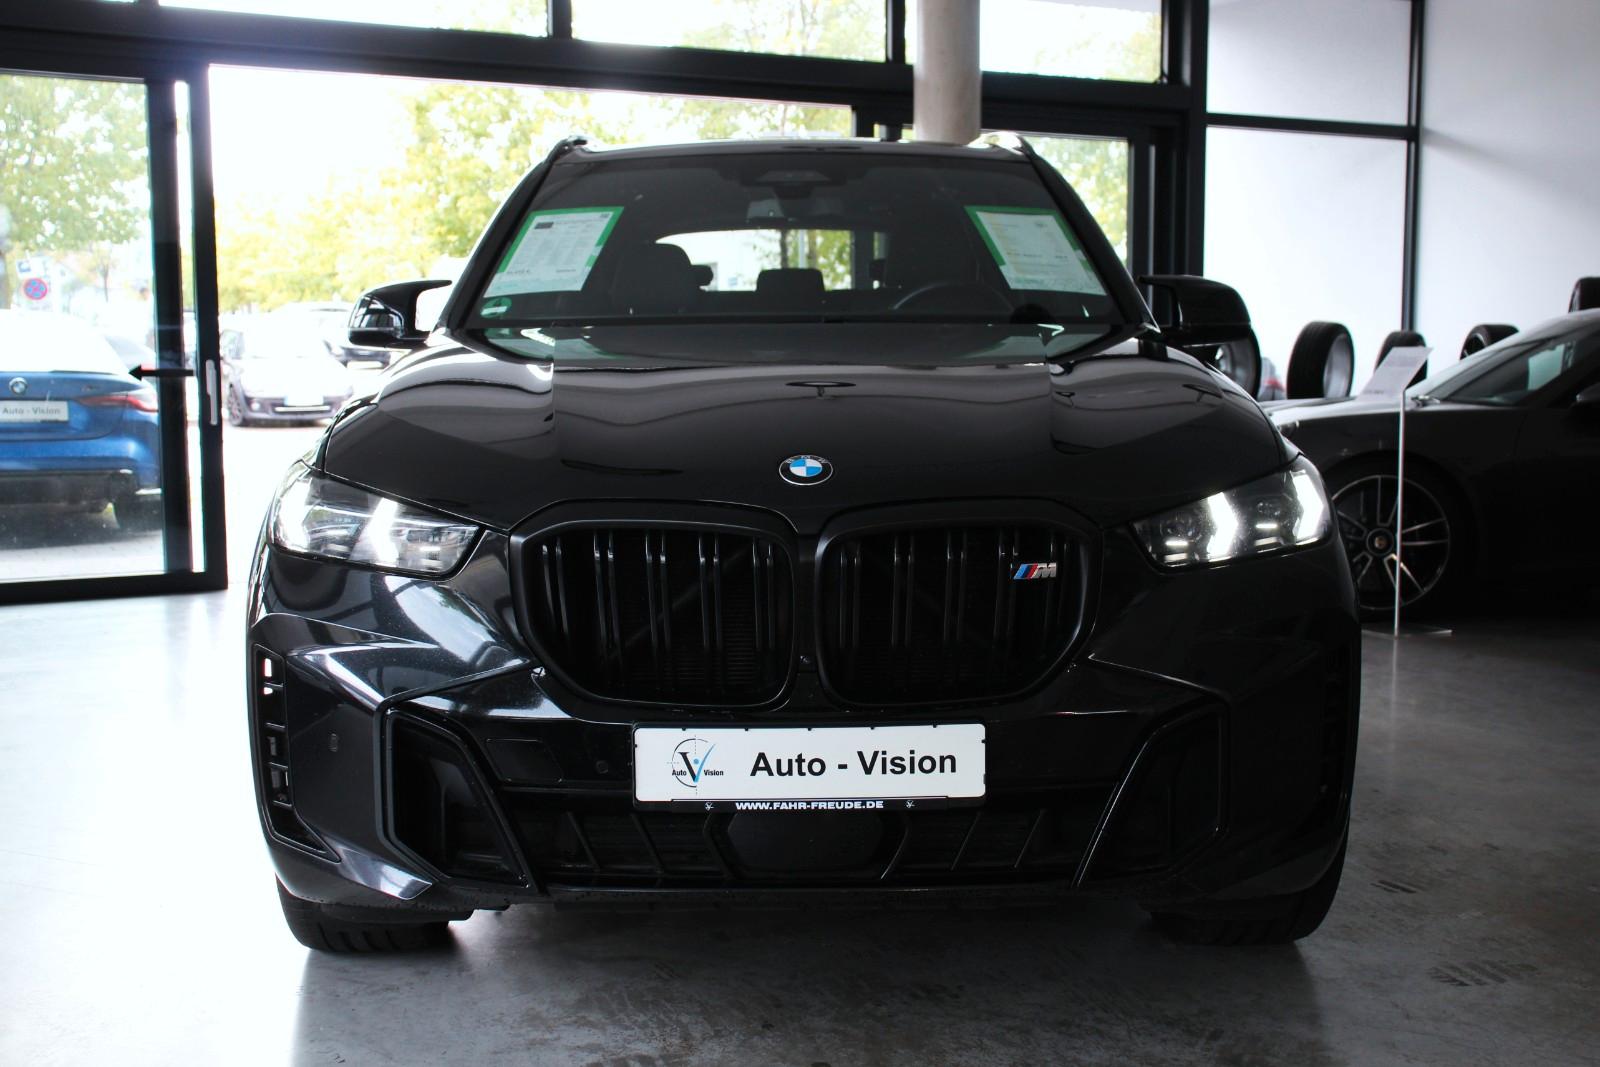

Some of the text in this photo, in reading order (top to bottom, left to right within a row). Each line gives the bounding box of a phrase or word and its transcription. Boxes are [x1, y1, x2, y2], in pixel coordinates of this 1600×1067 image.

[2, 406, 25, 416] Auto
[32, 406, 62, 416] Vision
[750, 752, 826, 777] Auto
[857, 749, 957, 776] Vision
[735, 800, 884, 810] WWW.FAHR-FREUDE.DE
